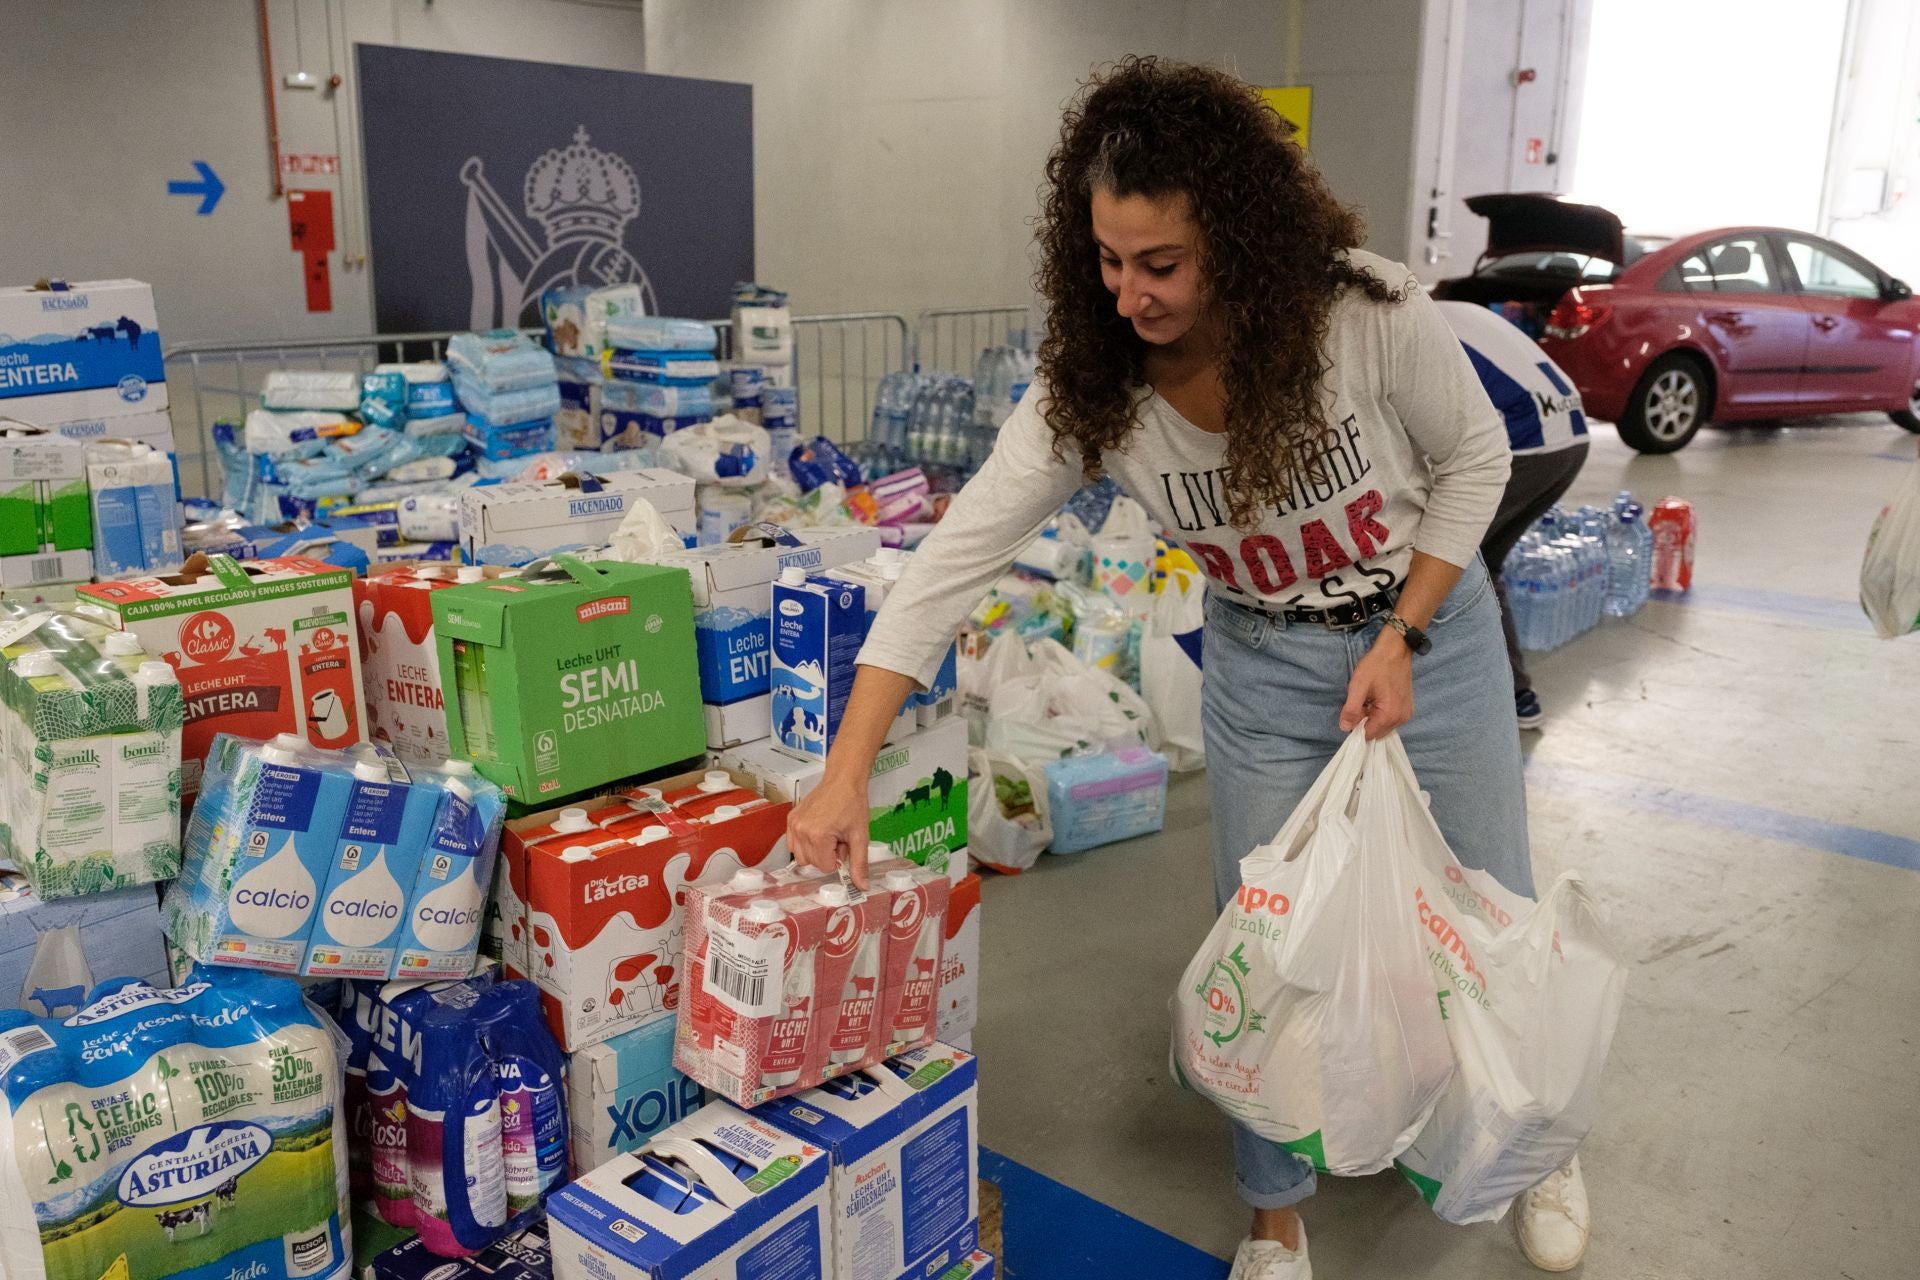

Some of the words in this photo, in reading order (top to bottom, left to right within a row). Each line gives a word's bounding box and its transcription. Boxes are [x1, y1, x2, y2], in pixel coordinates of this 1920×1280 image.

[0, 352, 29, 367] eche
[569, 497, 623, 515] HACENDADO
[1186, 488, 1390, 596] ROAR
[778, 550, 821, 572] HACENDADO
[127, 605, 149, 616] CAJA
[150, 601, 175, 613] 100%
[176, 597, 203, 608] PAPEL
[204, 590, 249, 604] RECICLADO
[258, 583, 295, 596] ENVASES
[296, 574, 348, 590] SOSTENIBLES
[580, 598, 627, 619] milsani
[780, 618, 803, 632] Leche
[780, 628, 800, 638] ENTERA
[728, 632, 765, 655] Leche
[311, 661, 340, 672] ENTERA
[557, 650, 593, 672] Leche
[595, 645, 622, 662] UHT
[730, 651, 770, 685] ENT
[397, 664, 428, 682] LECHE
[188, 678, 222, 694] LECHE
[224, 674, 246, 687] UHT
[387, 678, 445, 711] ENTERA
[560, 659, 639, 709] SEMI
[563, 690, 665, 735] DESNATADA
[872, 750, 909, 776] ACENDADO
[255, 811, 287, 823] Entera
[348, 825, 377, 837] Entera
[890, 816, 956, 858] NATADA
[438, 836, 467, 850] Entera
[235, 887, 310, 910] calcio
[330, 898, 398, 919] calcio
[939, 962, 965, 988] TERA
[904, 980, 933, 998] LECHE
[842, 999, 873, 1016] LECHE
[910, 996, 923, 1007] UHT
[1208, 987, 1236, 1015] 0%
[773, 1018, 807, 1037] LECHE
[849, 1015, 862, 1028] UHT
[903, 1014, 922, 1024] ENTERA
[781, 1036, 796, 1049] UHT
[840, 1034, 862, 1045] ENTERA
[269, 1046, 289, 1059] FILM
[772, 1057, 796, 1068] ENTERA
[188, 1059, 227, 1075] ENVASES
[271, 1055, 313, 1083] 50%
[193, 1070, 245, 1104] 100%
[273, 1073, 323, 1092] MATERIALES
[273, 1083, 323, 1103] RECICLADOS
[91, 1091, 130, 1110] ENVASE
[96, 1092, 157, 1130] CERO
[104, 1112, 163, 1144] EMISIONES
[729, 1124, 758, 1142] LECHE
[757, 1138, 777, 1150] UHT
[745, 1118, 782, 1141] Auchan
[149, 1149, 205, 1171] CENTRAL
[208, 1131, 255, 1155] LECHERA
[713, 1126, 773, 1161] SEMIDESNATADA
[126, 1139, 262, 1202] ASTURIANA
[855, 1161, 886, 1187] Auchan
[850, 1180, 875, 1202] LECHE
[876, 1168, 891, 1185] UHT
[846, 1176, 896, 1219] SEMIDESNATADA
[295, 1236, 324, 1252] AENOR
[392, 1247, 403, 1257] 6
